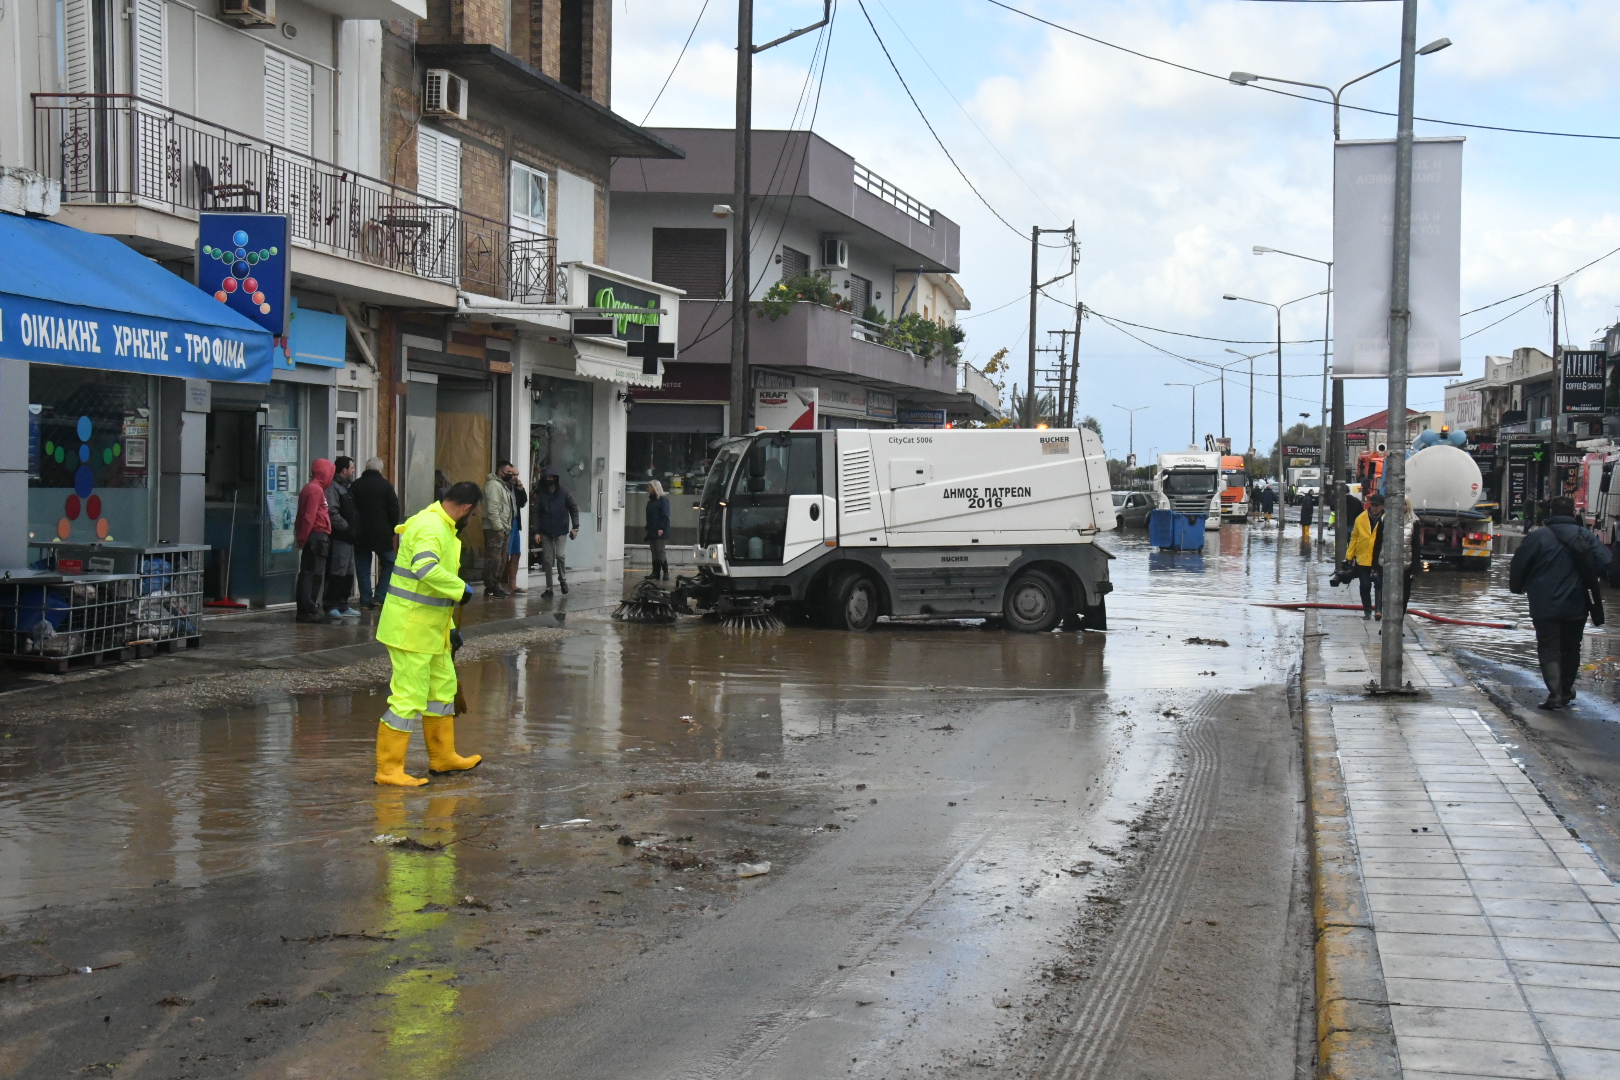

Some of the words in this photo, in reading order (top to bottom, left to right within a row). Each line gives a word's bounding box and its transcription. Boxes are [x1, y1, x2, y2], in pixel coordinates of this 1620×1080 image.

[20, 313, 101, 354] ΟΙΚΙΑΚΗΣ
[112, 324, 169, 362] ΧΡΗΣΗΣ
[184, 333, 247, 370] ΤΡΟΦΙΜΑ
[1565, 354, 1598, 376] AVENUE
[759, 391, 788, 399] KRAFT
[910, 412, 942, 420] AUTOCOLOR
[888, 436, 914, 444] CityCat
[916, 436, 933, 444] 5006
[943, 488, 979, 499] ΔΗΜΟΣ
[984, 487, 1031, 498] ΠΑΤΡΕΩΝ
[968, 497, 1003, 509] 2016
